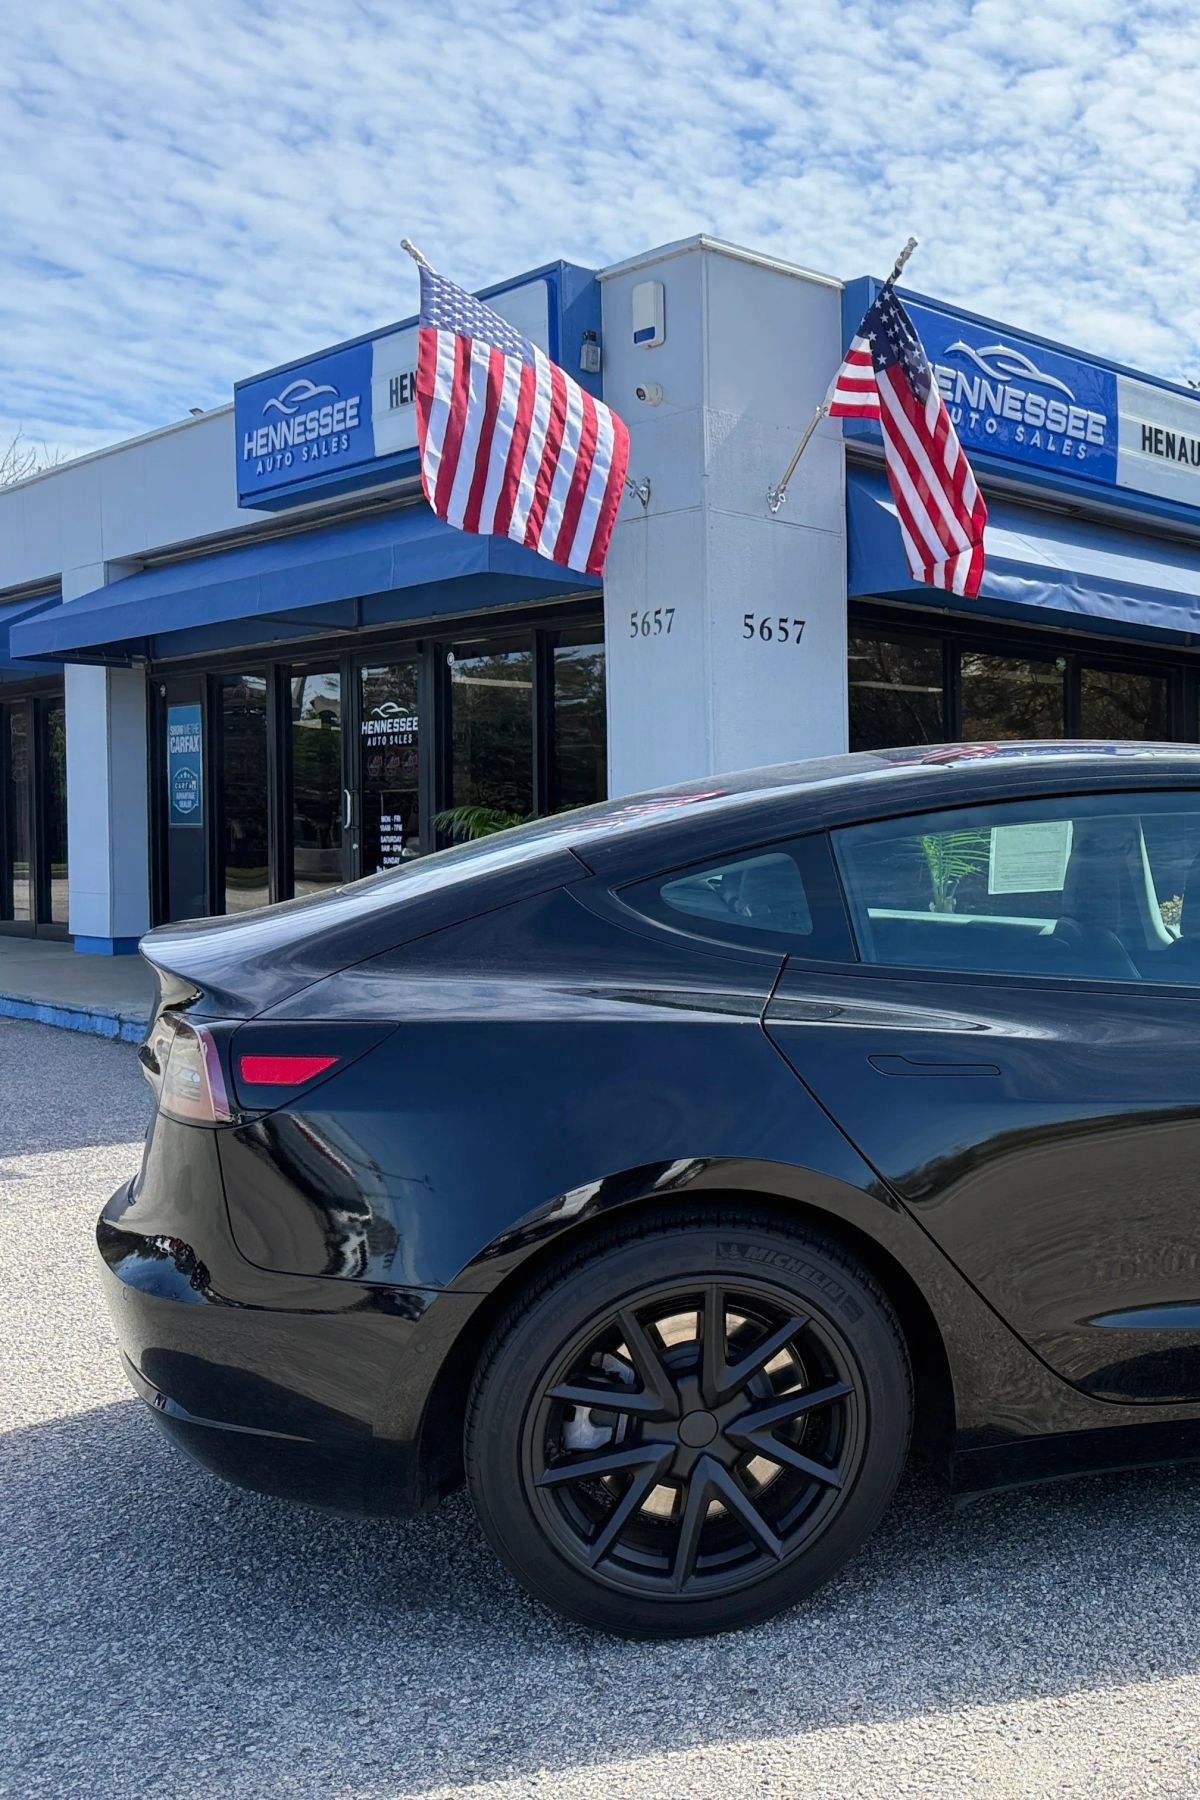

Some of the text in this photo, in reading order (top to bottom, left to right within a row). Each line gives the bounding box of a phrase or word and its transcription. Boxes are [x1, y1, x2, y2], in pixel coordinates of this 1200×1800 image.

[927, 361, 1107, 446] ENNESSEE
[244, 396, 360, 460] HENNESSEE
[951, 407, 1087, 460] UTO SALES
[256, 435, 349, 476] AUTO SALES
[630, 608, 675, 638] 5657
[743, 613, 806, 644] 5657
[361, 716, 418, 735] HENNESSEE
[367, 734, 412, 746] AUTO SALES
[170, 736, 199, 753] CARFAX
[744, 1246, 846, 1300] MICHELIN
